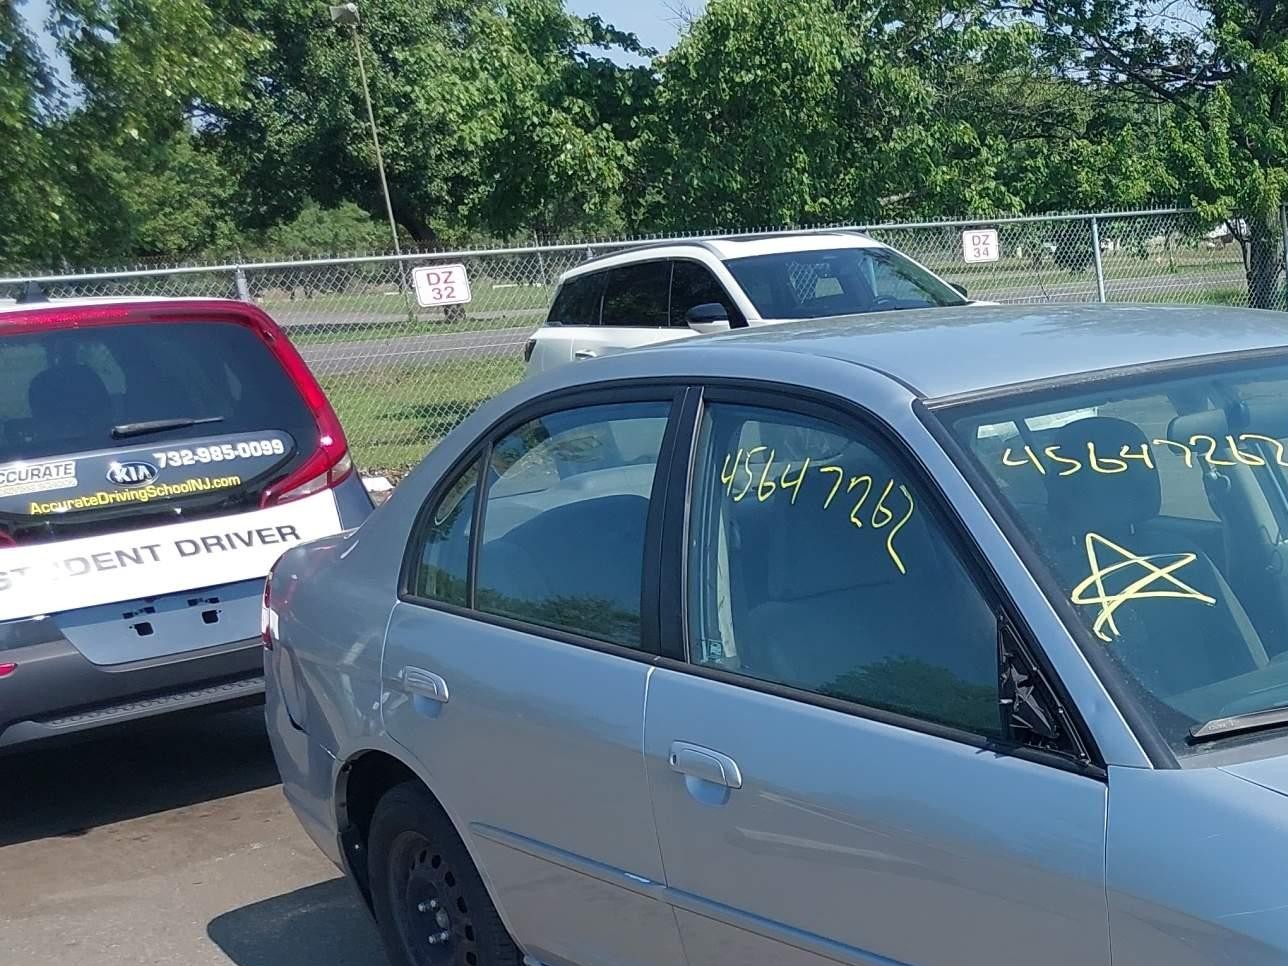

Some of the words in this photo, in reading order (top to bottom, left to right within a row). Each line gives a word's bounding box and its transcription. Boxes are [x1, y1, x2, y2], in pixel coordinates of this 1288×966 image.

[971, 234, 991, 246] DZ
[973, 247, 989, 258] 34
[426, 270, 456, 286] DZ
[431, 286, 456, 300] 32
[152, 438, 285, 469] 732-985-0099
[115, 463, 152, 483] KIA
[30, 475, 241, 515] AccurateDrivingSchoolNJ.com
[720, 446, 915, 575] 45647262
[0, 544, 161, 591] STDENT
[174, 524, 301, 558] DRIVER
